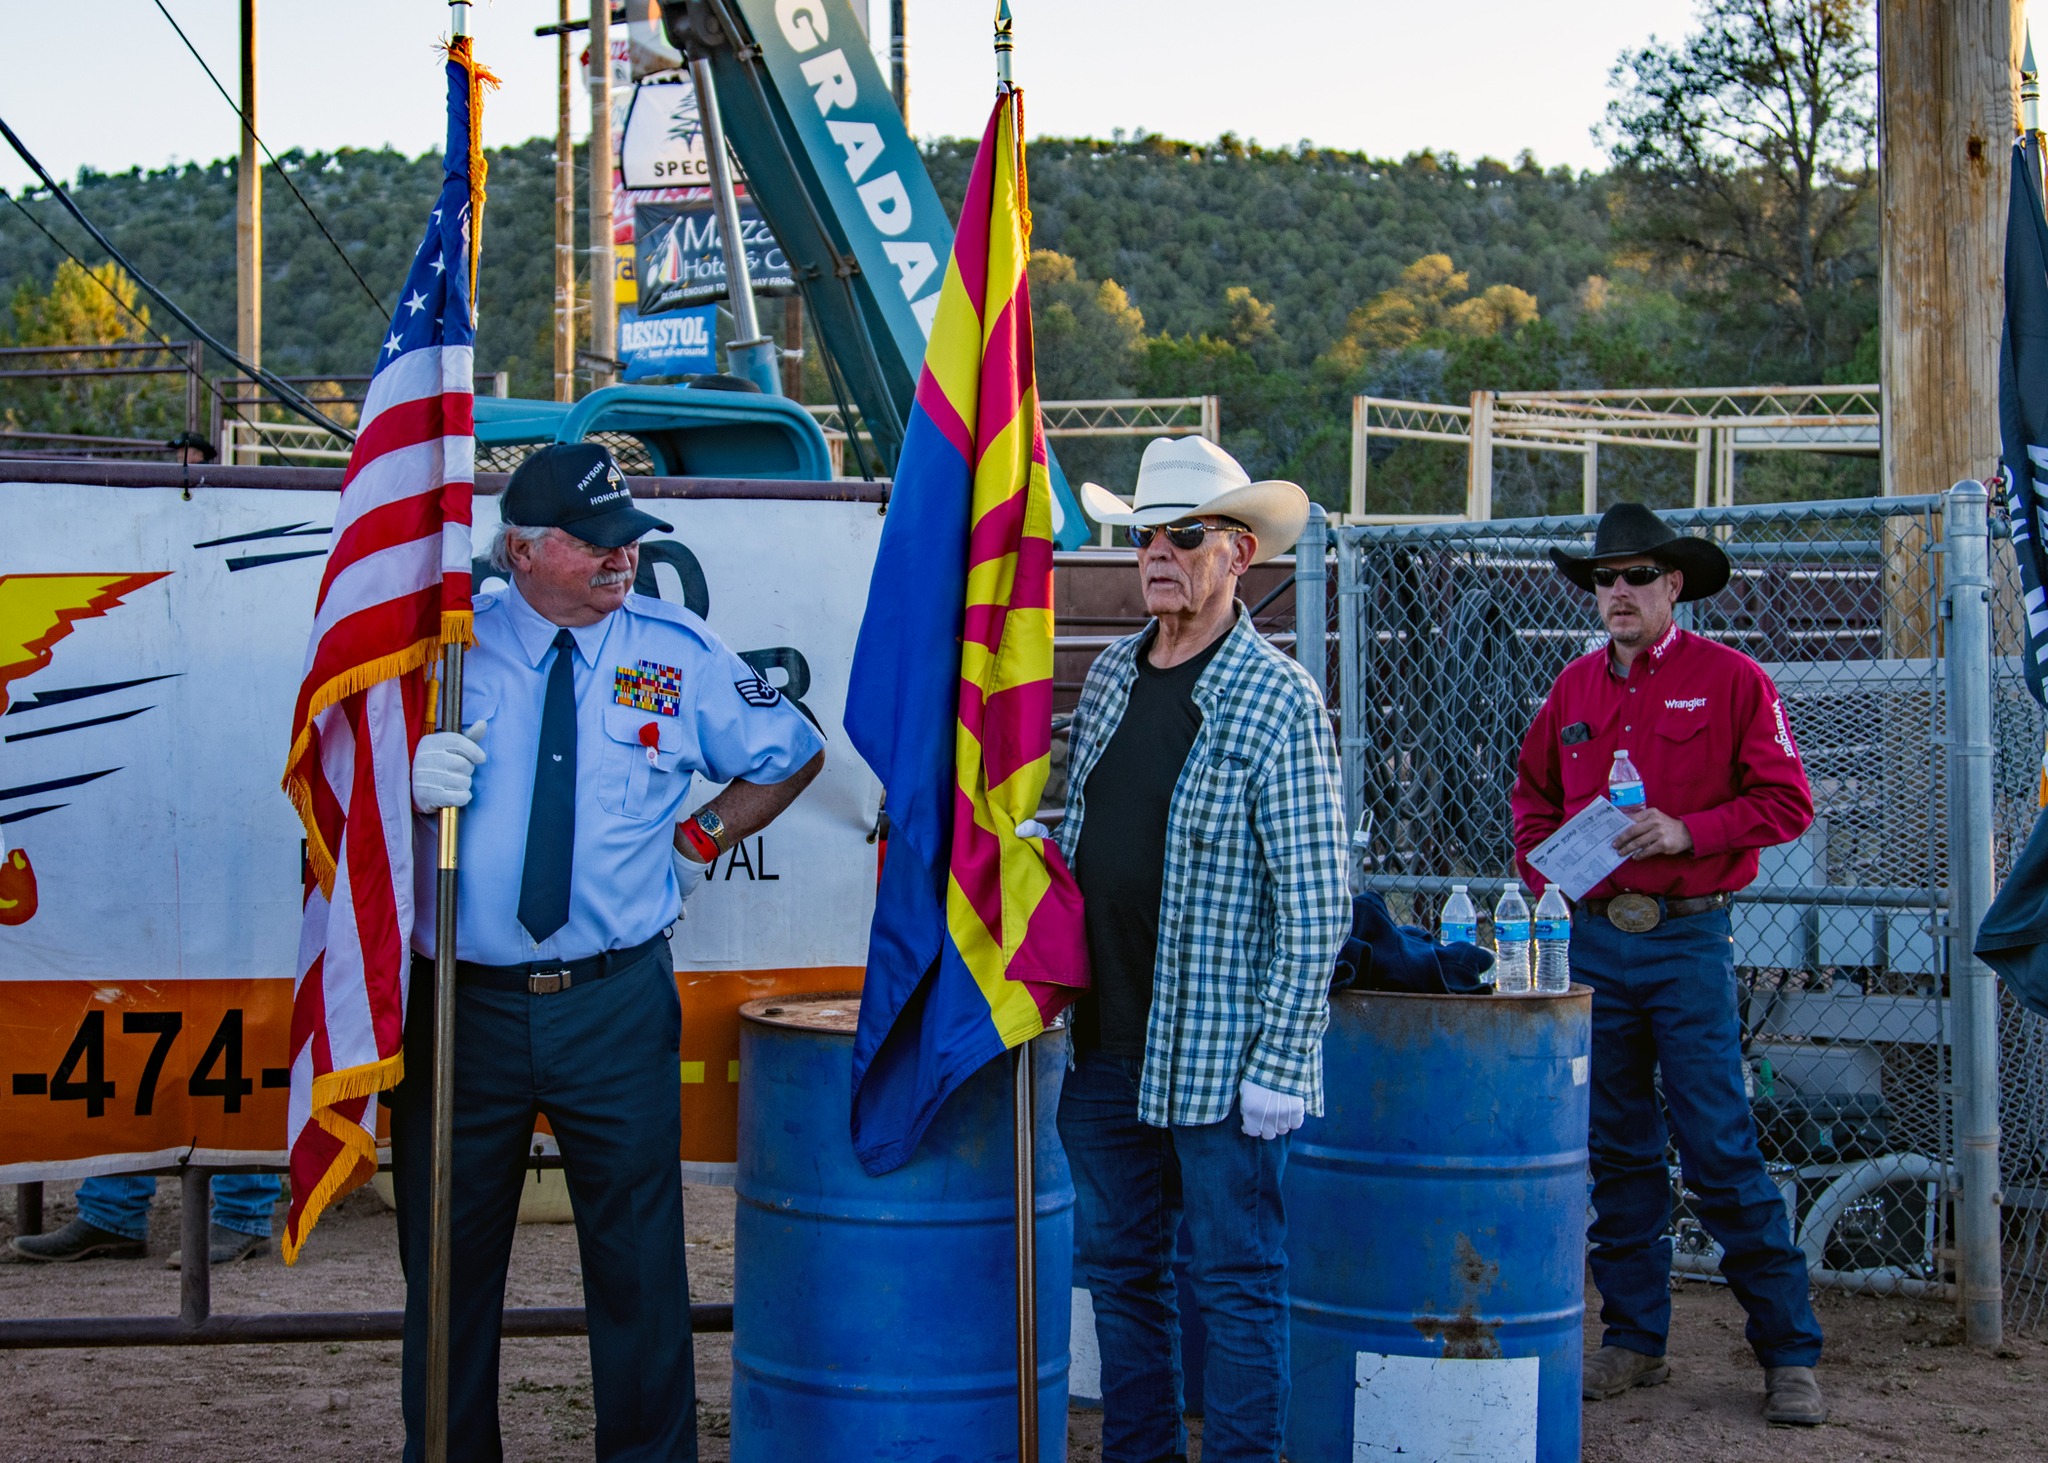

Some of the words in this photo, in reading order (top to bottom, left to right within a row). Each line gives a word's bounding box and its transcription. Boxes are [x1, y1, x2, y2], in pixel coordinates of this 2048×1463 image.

[683, 285, 714, 296] ENOUGH
[715, 282, 726, 292] TO
[621, 316, 709, 352] RESISTOL
[577, 461, 605, 491] PAYSON
[590, 491, 620, 506] HONOR
[1664, 697, 1707, 712] Wrangler
[1772, 698, 1796, 759] Wrangler
